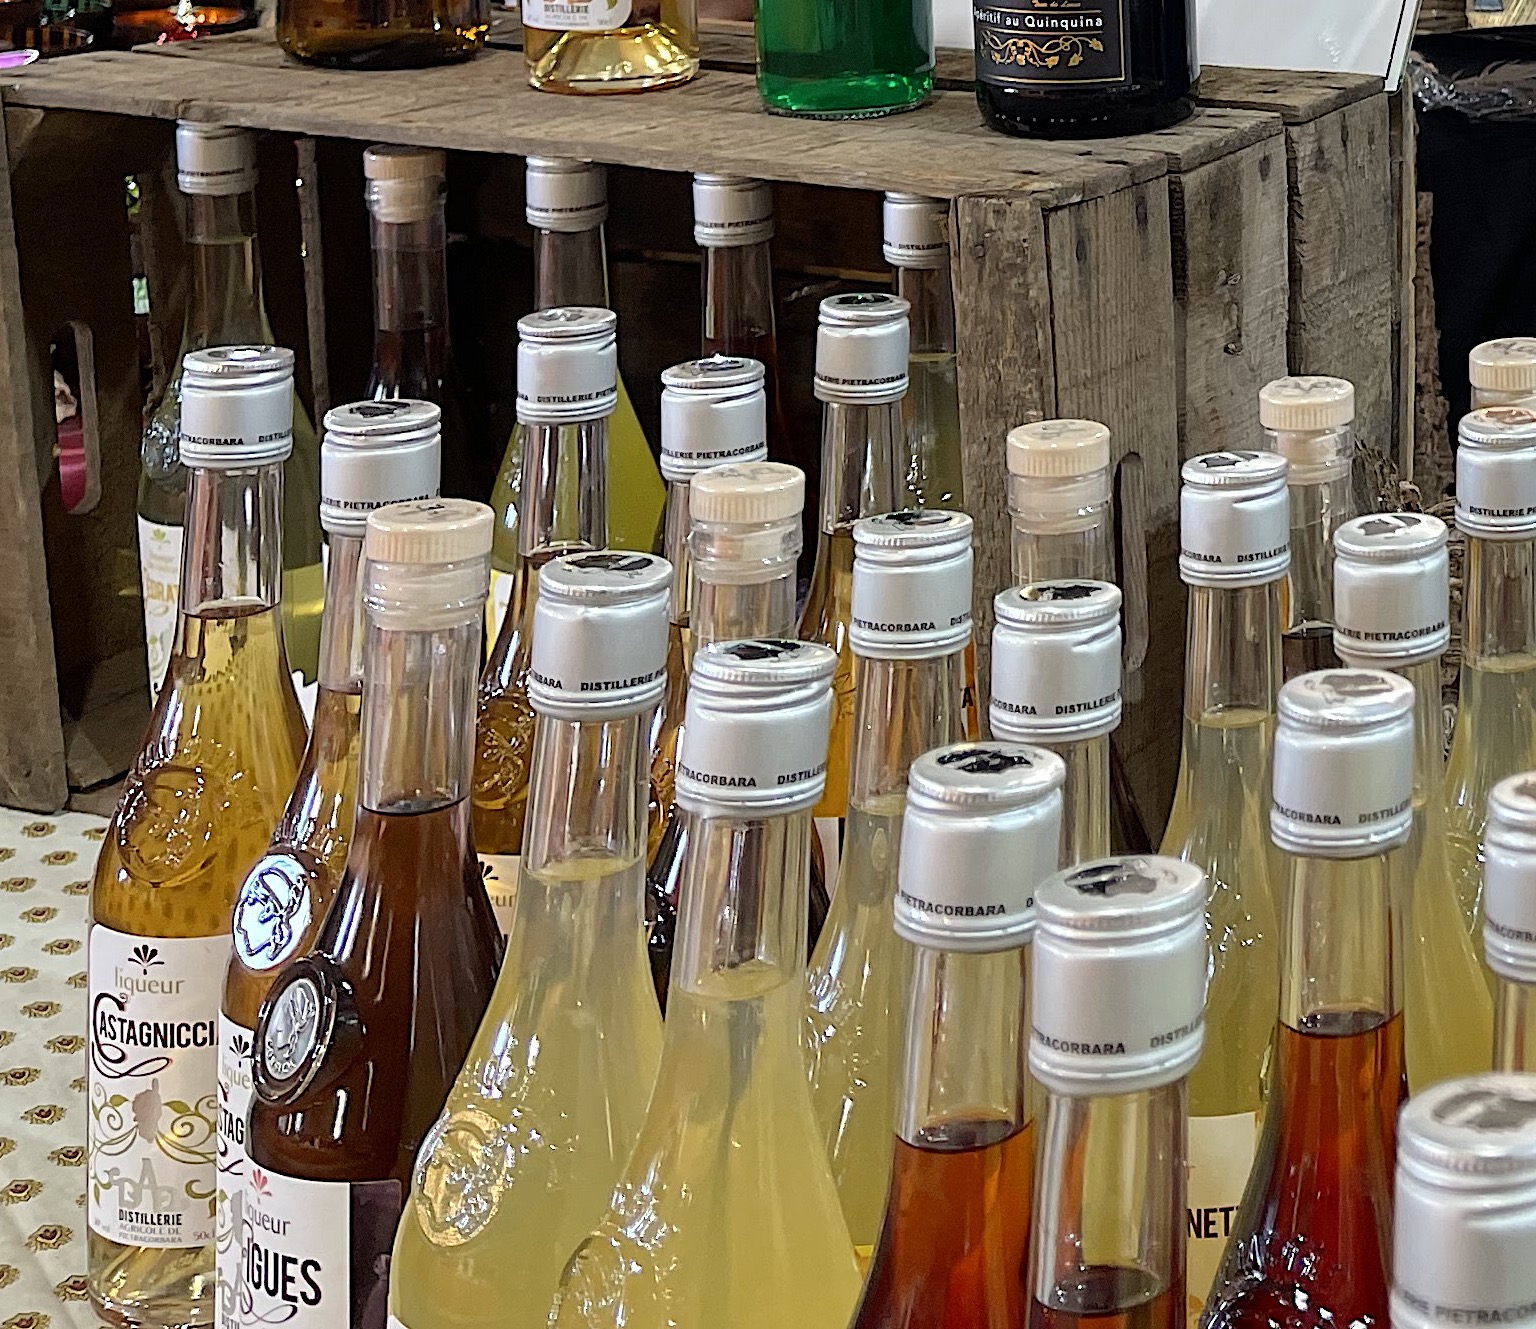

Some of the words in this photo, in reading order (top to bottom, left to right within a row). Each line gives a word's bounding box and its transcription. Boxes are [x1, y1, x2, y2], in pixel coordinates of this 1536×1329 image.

[1005, 16, 1020, 27] au
[1024, 15, 1104, 31] Quinquina
[580, 672, 653, 692] DISTILLERIE
[114, 966, 186, 997] liqueur
[92, 992, 219, 1064] CASTAGNICCI
[118, 1208, 183, 1226] DISTILLERIE
[1188, 1205, 1239, 1239] NET
[246, 1235, 323, 1306] IGUES
